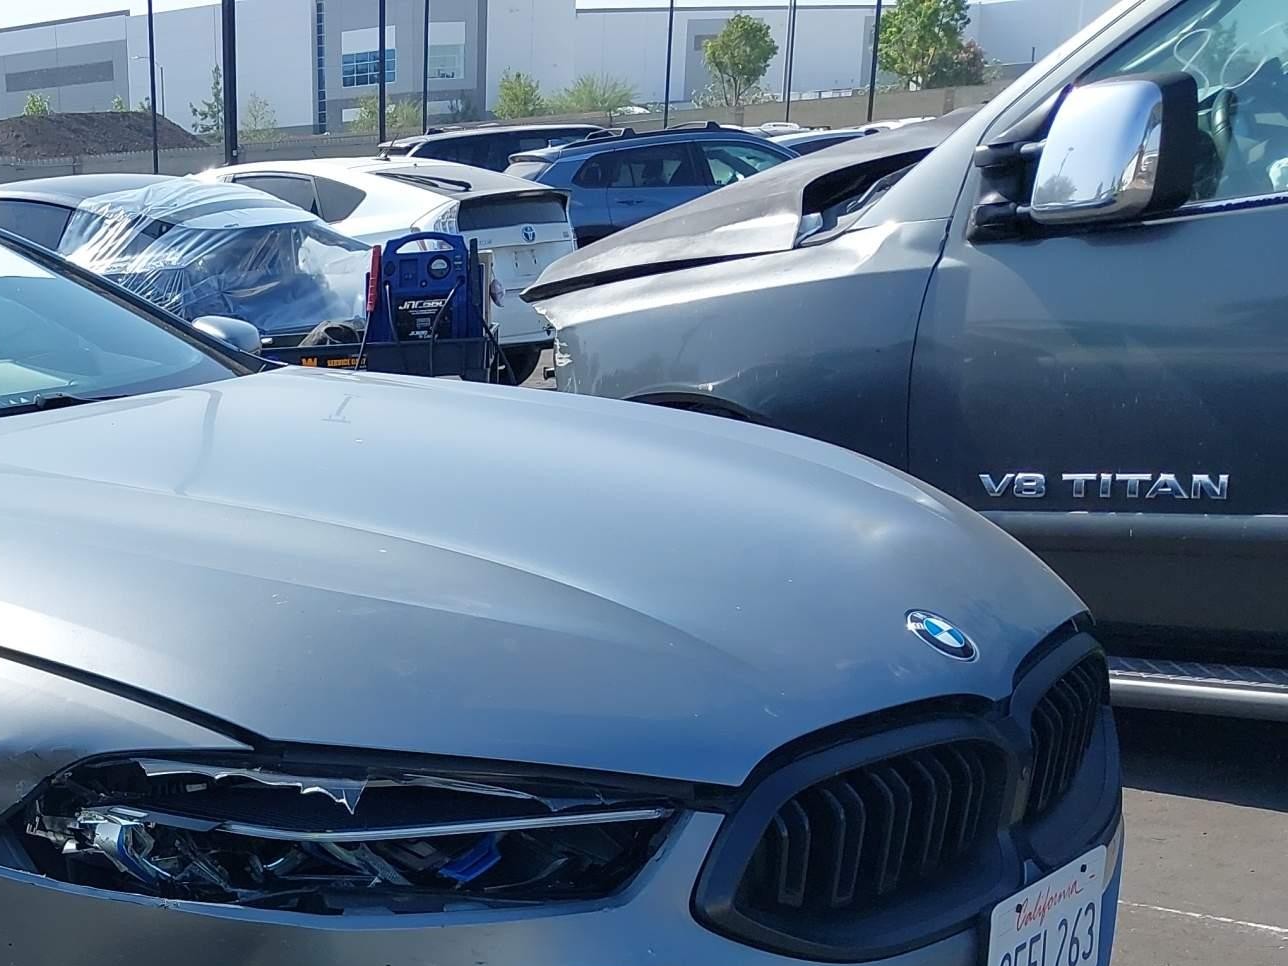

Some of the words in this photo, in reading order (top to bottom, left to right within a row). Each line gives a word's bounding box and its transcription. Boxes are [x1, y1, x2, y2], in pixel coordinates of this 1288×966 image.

[978, 472, 1046, 498] V8
[1062, 472, 1229, 500] TITAN
[1016, 880, 1084, 931] California
